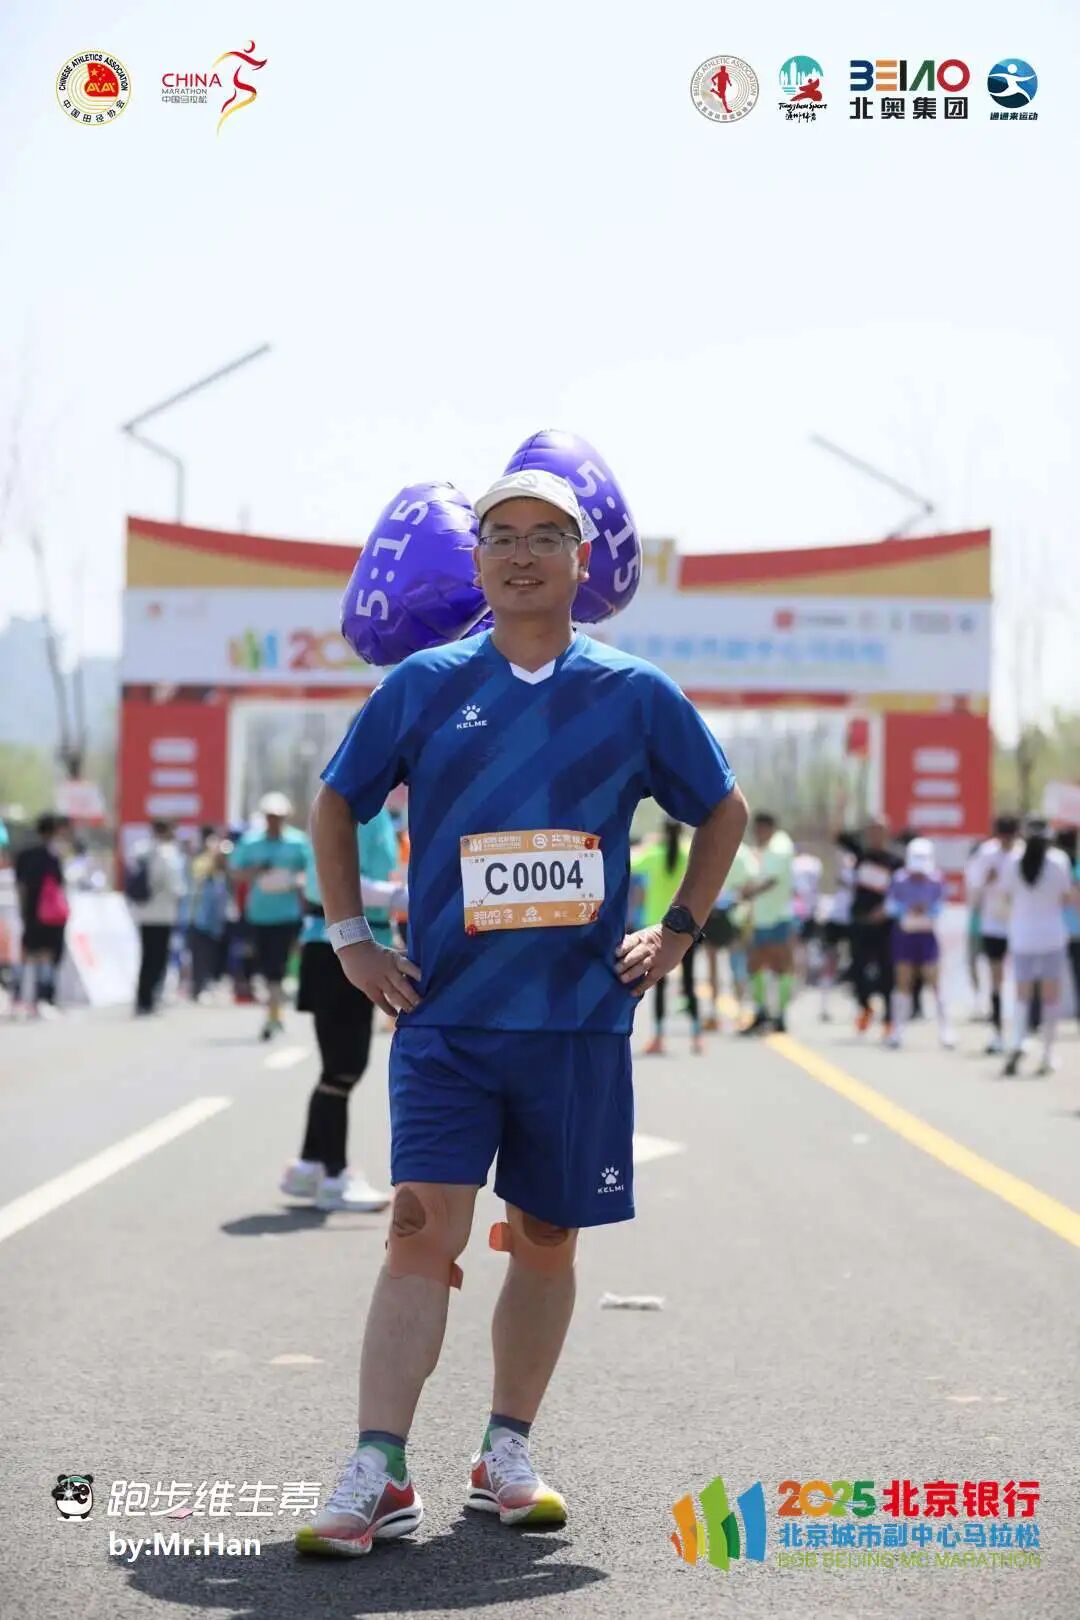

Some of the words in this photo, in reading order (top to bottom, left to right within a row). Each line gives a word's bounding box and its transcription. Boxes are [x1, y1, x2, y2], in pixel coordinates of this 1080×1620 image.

[355, 499, 430, 621] 5:15
[564, 460, 639, 593] 5:15
[456, 720, 488, 730] KELME
[485, 860, 584, 896] C0004
